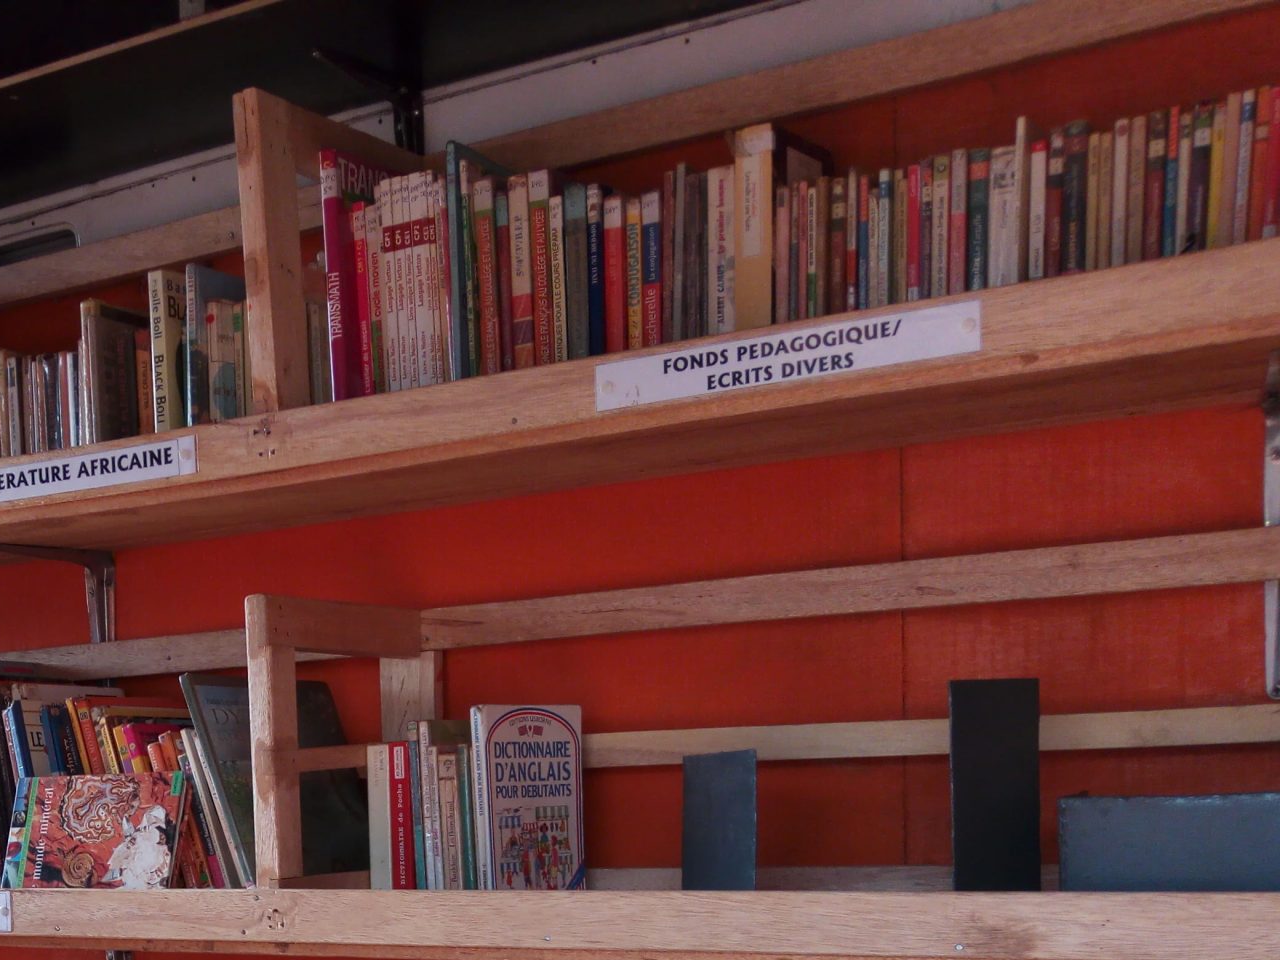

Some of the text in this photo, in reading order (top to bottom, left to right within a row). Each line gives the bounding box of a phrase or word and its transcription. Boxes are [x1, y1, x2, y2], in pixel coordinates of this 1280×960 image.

[551, 227, 560, 262] PREPARA
[552, 263, 561, 289] COURS
[328, 271, 342, 341] TRANSMATH
[554, 301, 562, 323] POUR
[646, 288, 657, 345] escherelle
[554, 323, 563, 362] MATIQUES
[663, 318, 903, 375] FONDS PEDAGOGIQUE/
[706, 352, 854, 391] ECRITS DIVERS
[77, 446, 173, 478] AFRICAINE
[30, 731, 45, 748] LE
[494, 741, 571, 758] DICTIONNAIRE
[495, 762, 571, 782] D'ANGLAIS
[496, 783, 571, 799] POUR DEBUTANTS
[33, 786, 56, 880] monde minéral
